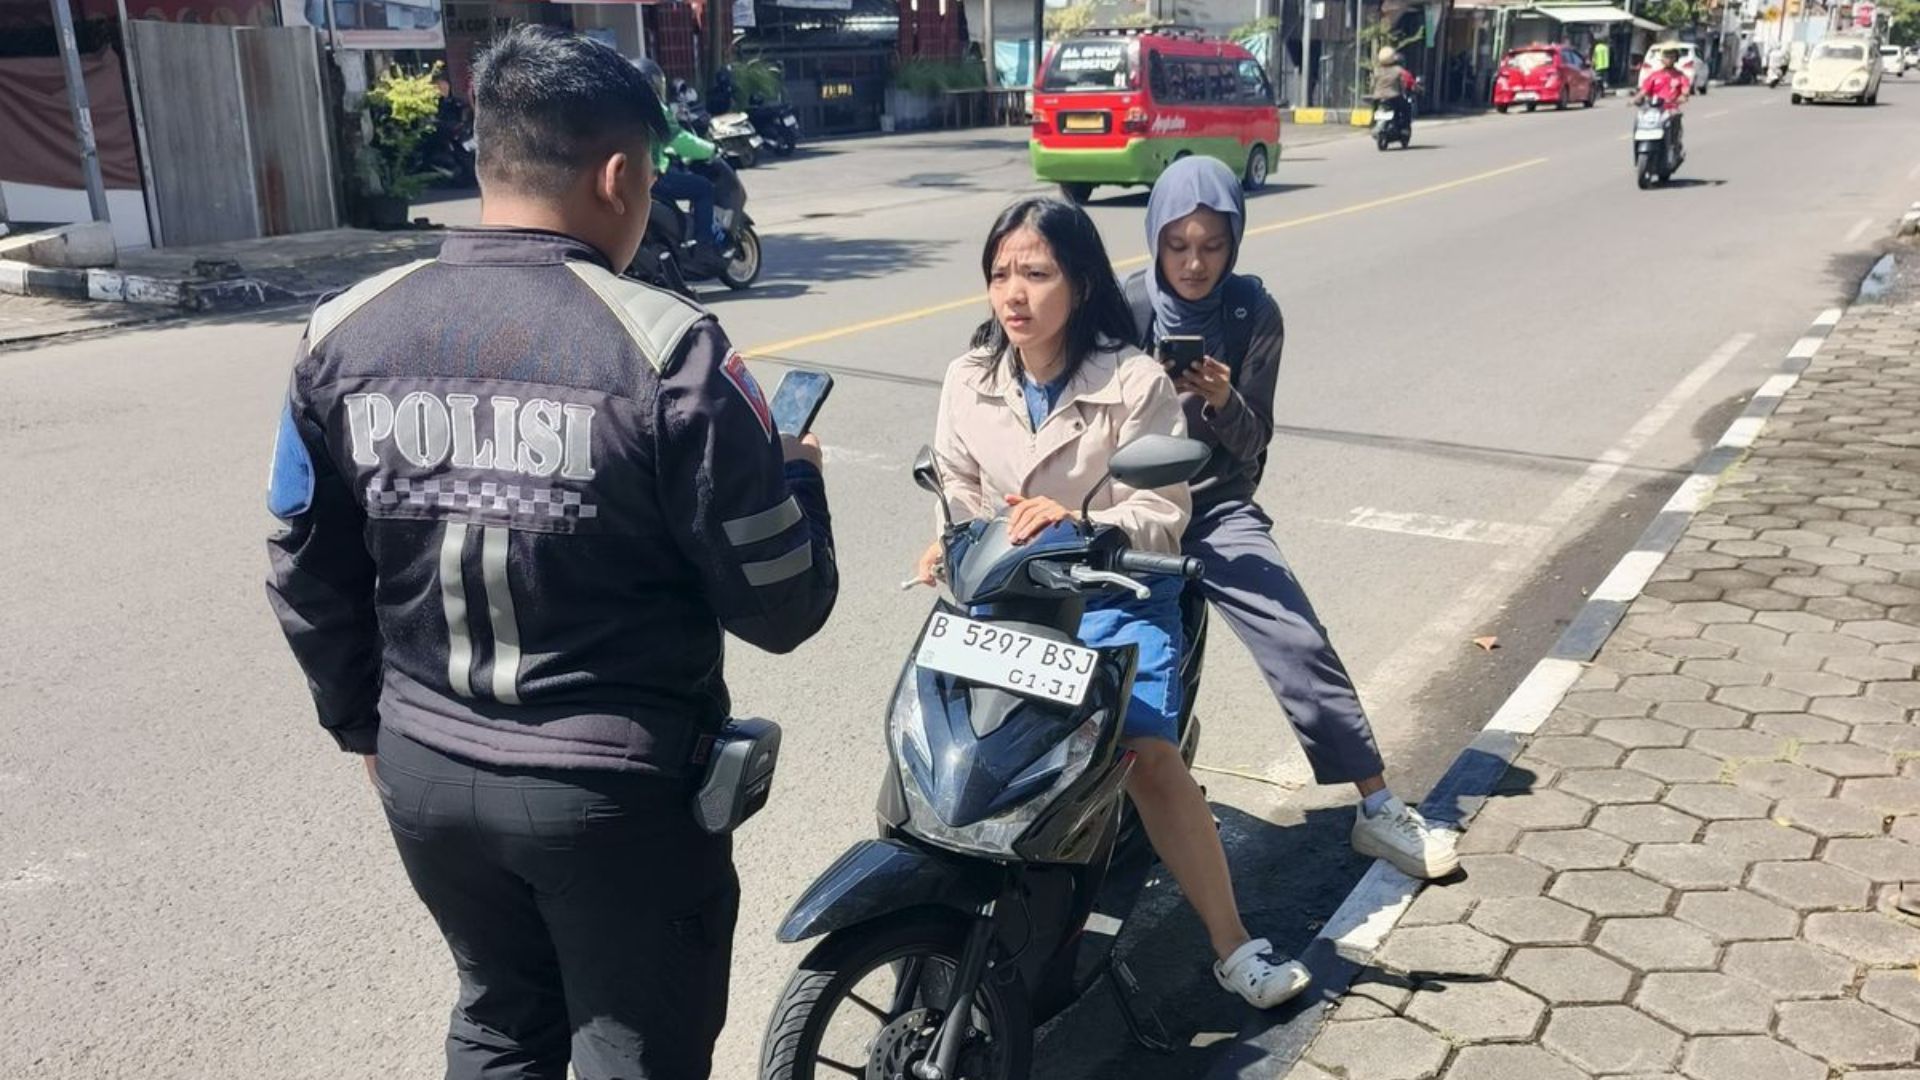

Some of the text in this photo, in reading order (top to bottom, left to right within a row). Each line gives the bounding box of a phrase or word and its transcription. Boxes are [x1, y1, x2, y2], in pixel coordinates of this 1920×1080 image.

[344, 391, 596, 480] POLISI
[932, 616, 1094, 675] B 5297 BSJ
